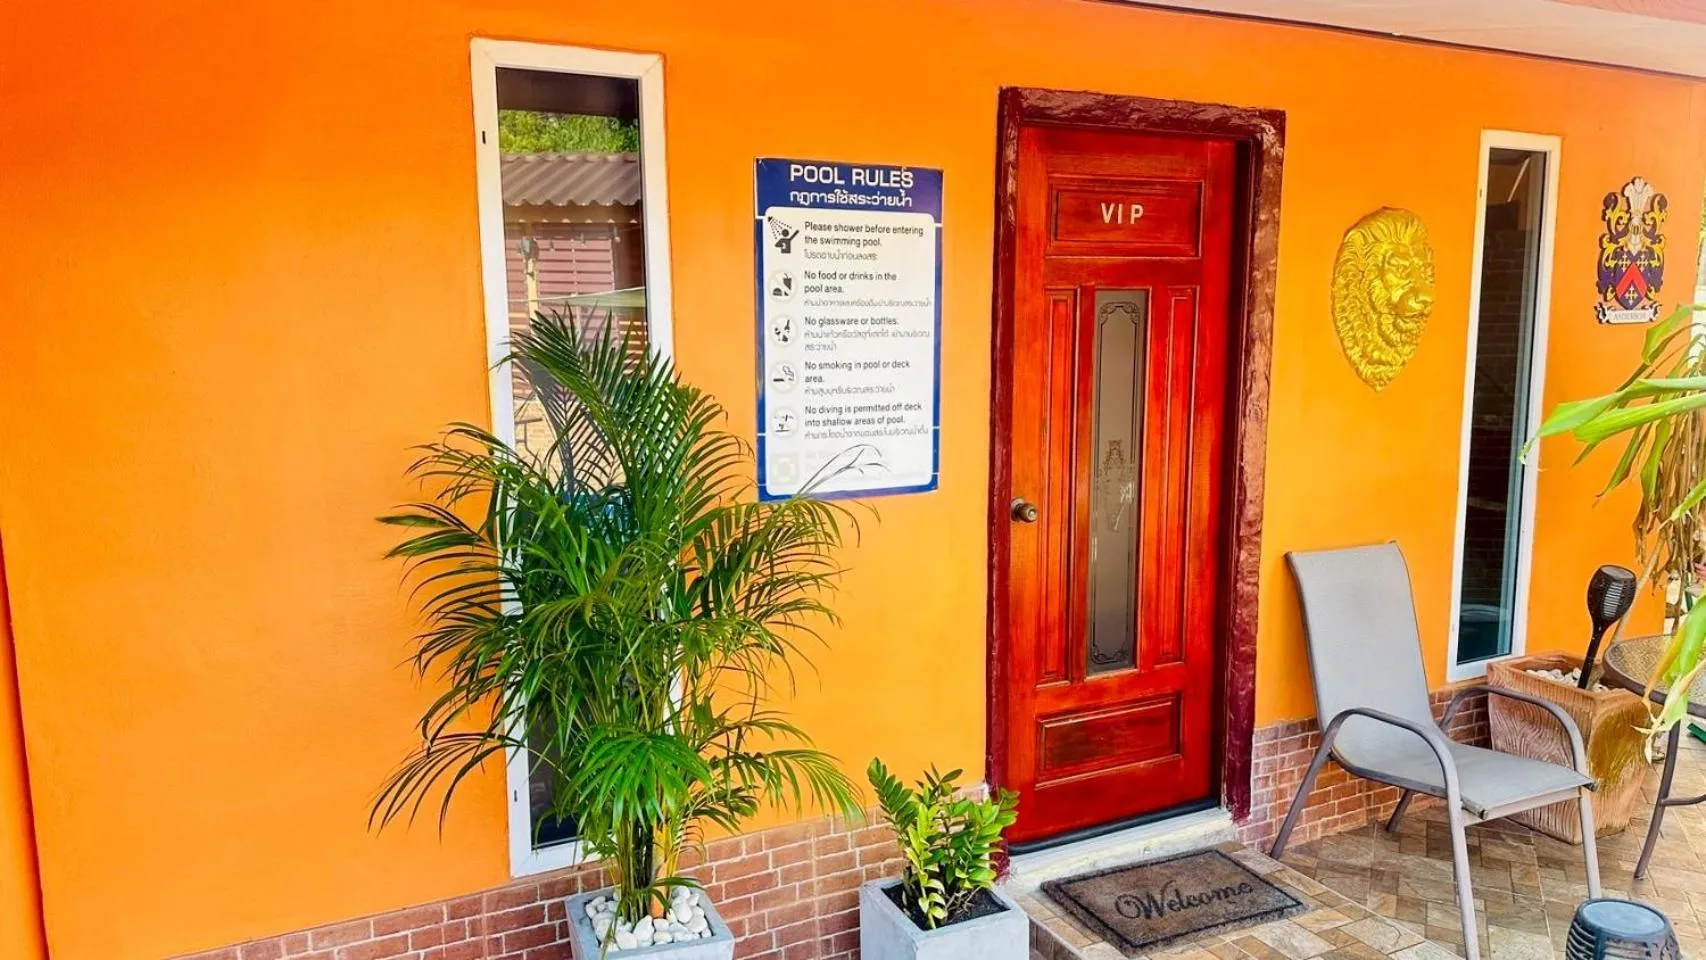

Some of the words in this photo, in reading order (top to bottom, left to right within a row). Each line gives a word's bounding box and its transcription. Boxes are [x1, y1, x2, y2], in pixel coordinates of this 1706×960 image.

[789, 164, 845, 185] POOL
[852, 168, 914, 188] RULES
[1100, 202, 1145, 225] VIP
[804, 221, 832, 232] Please
[833, 223, 864, 233] shower
[865, 224, 891, 234] before
[892, 225, 924, 237] entering
[804, 235, 818, 245] the
[819, 236, 861, 248] swimming
[862, 237, 882, 248] pool.
[804, 270, 817, 280] No
[818, 271, 837, 280] food
[838, 273, 847, 281] or
[849, 271, 874, 281] drinks
[875, 272, 883, 281] in
[884, 272, 897, 281] the
[804, 284, 823, 295] pool
[824, 285, 844, 294] area.
[804, 316, 817, 325] No
[818, 316, 859, 328] glassware
[870, 316, 898, 325] bottles.
[805, 361, 817, 370] No
[818, 360, 853, 372] smoking
[854, 361, 862, 369] in
[863, 360, 881, 371] pool
[891, 360, 910, 369] deck
[804, 375, 825, 383] area.
[805, 405, 817, 415] No
[818, 405, 844, 416] diving
[845, 405, 852, 414] is
[853, 404, 890, 415] permitted
[891, 403, 903, 412] off
[904, 402, 922, 412] deck
[804, 418, 820, 427] into
[821, 416, 852, 427] shallow
[854, 418, 876, 426] areas
[877, 416, 885, 425] of
[886, 415, 905, 427] pool.
[1114, 879, 1254, 920] Welcome
